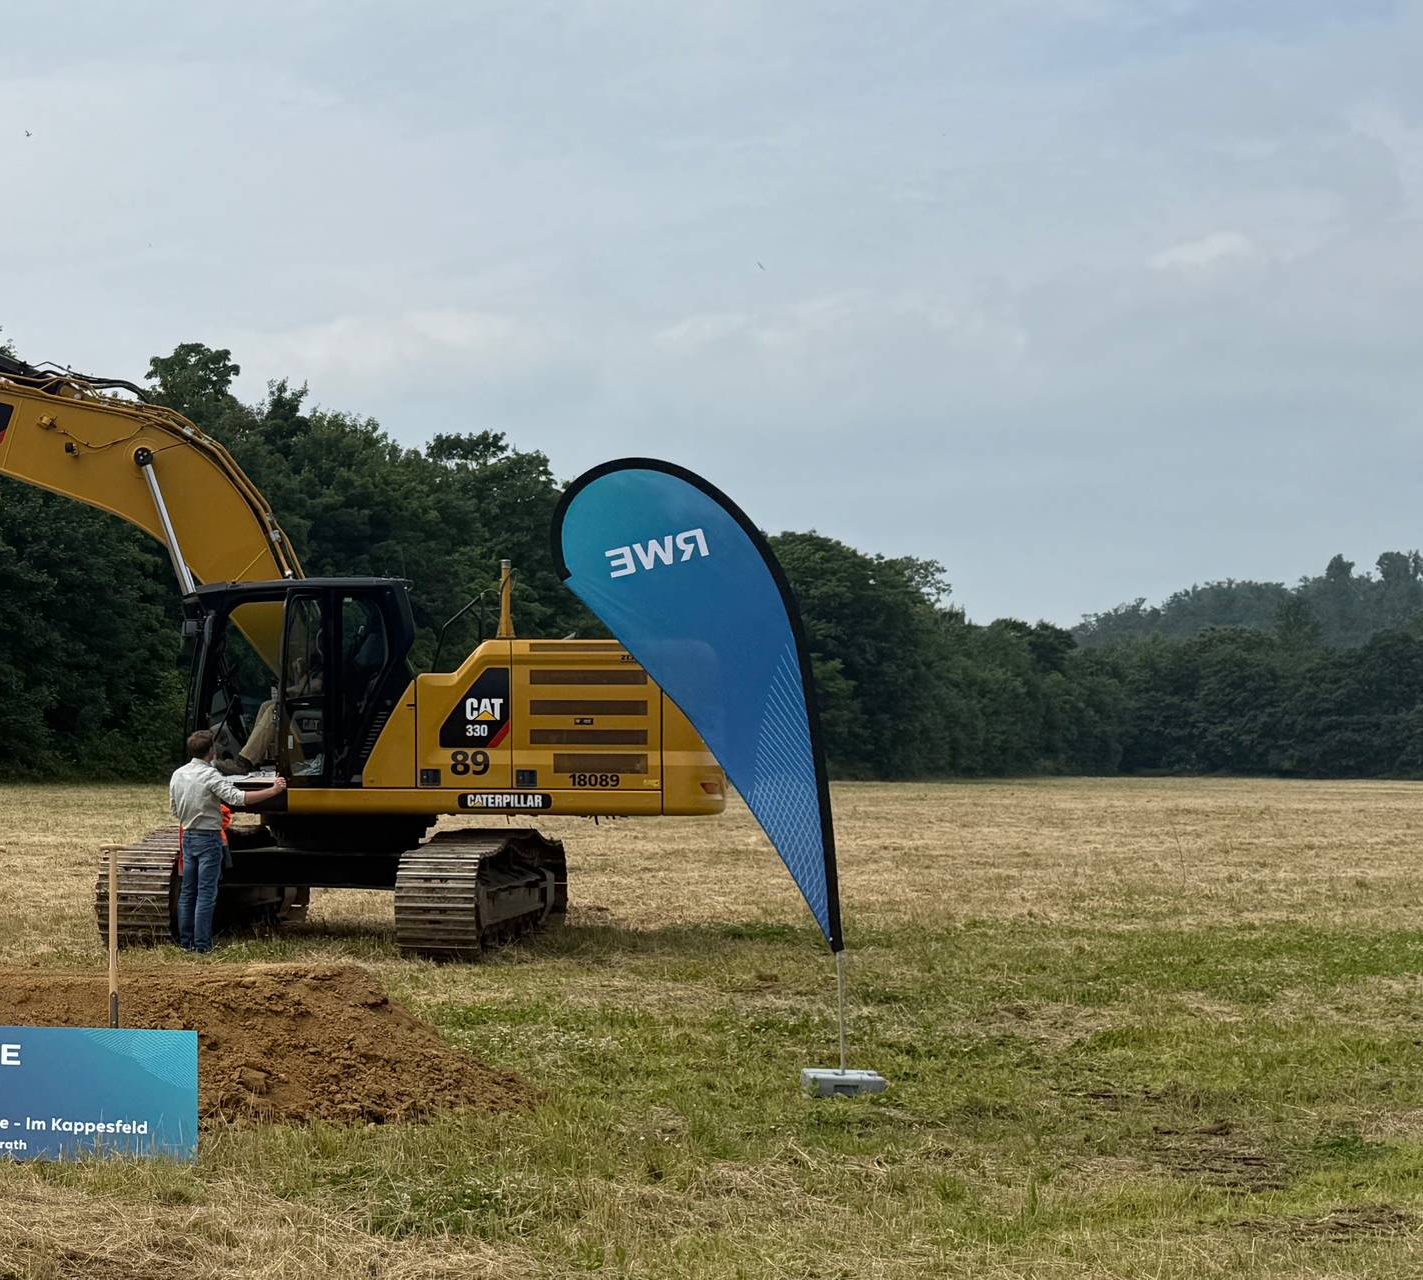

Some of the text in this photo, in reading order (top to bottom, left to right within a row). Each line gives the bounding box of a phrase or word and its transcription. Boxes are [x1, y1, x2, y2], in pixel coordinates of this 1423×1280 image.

[465, 698, 503, 721] CAT
[465, 724, 488, 737] 330
[450, 750, 490, 776] 89
[568, 773, 620, 787] 18089
[467, 795, 543, 808] CATERPILLAR
[26, 1117, 46, 1130] Im
[51, 1117, 148, 1136] Kappesfeld
